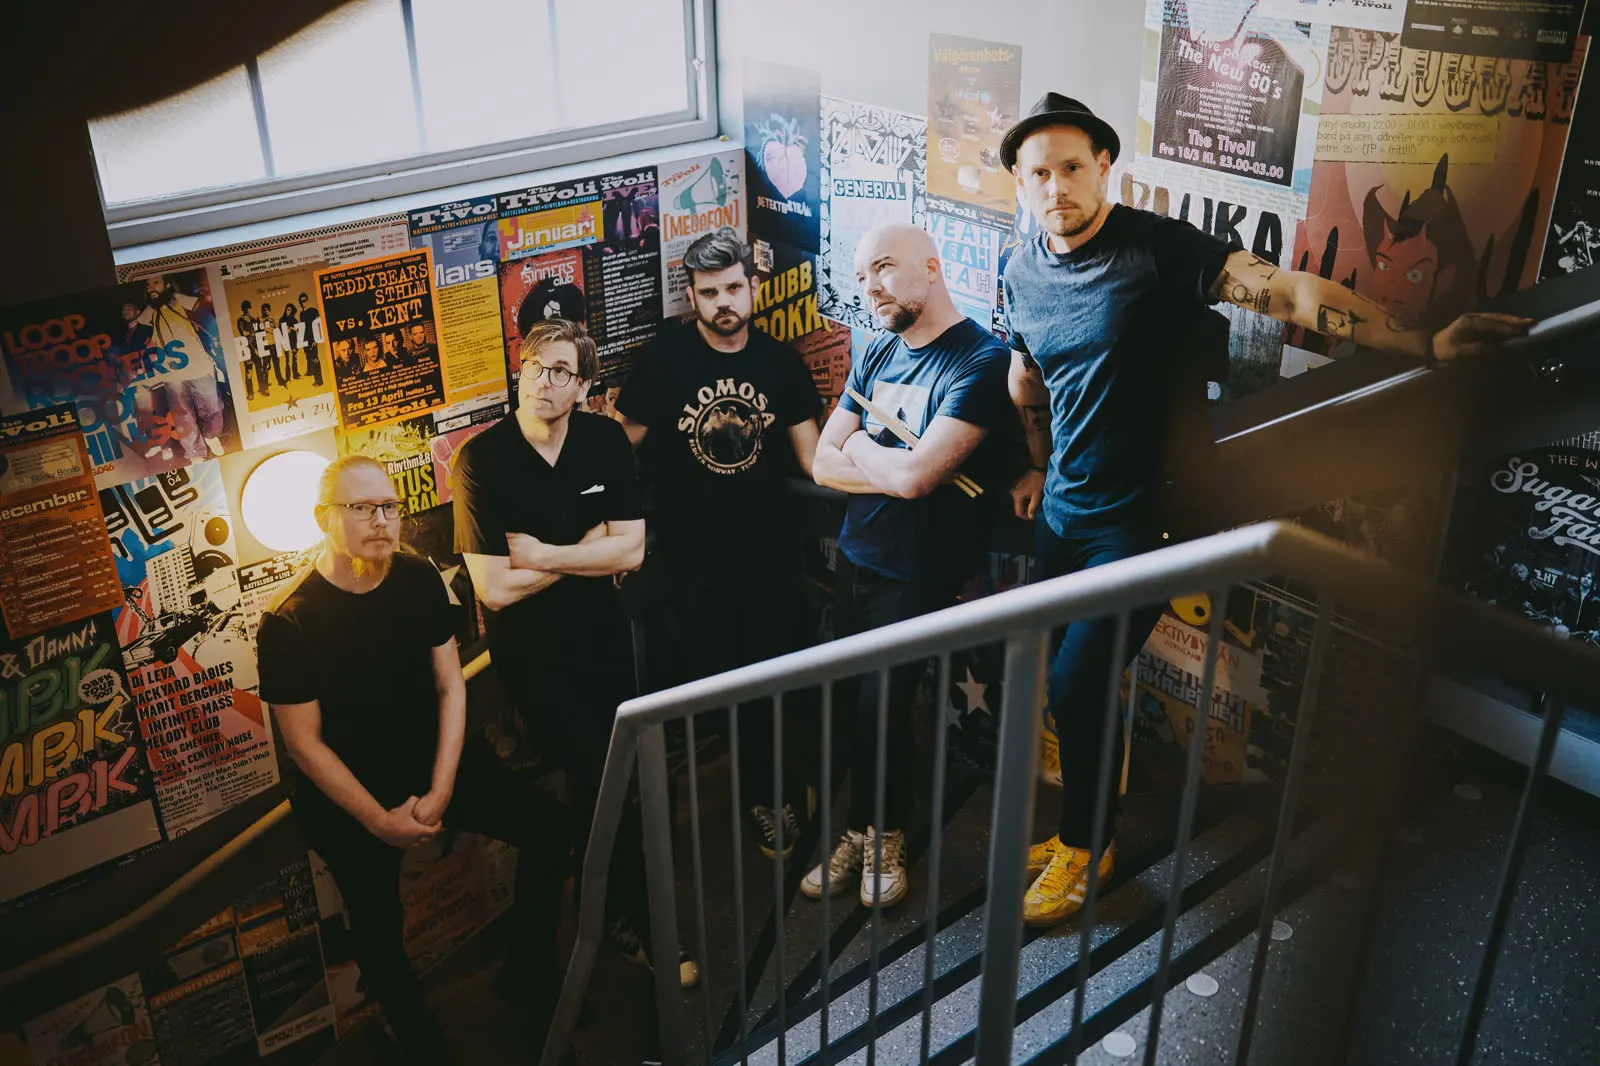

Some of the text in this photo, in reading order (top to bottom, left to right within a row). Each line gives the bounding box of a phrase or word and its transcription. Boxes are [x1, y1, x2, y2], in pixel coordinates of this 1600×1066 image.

[1178, 39, 1203, 64] The
[1208, 53, 1244, 82] New
[1188, 129, 1256, 157] The Tivoli
[1159, 142, 1175, 156] Fre
[1177, 145, 1200, 161] 18/3
[1219, 155, 1284, 179] 23.00-03.00
[528, 186, 556, 196] The
[600, 171, 655, 190] ivoli
[602, 181, 655, 201] IVE
[834, 179, 907, 200] GENERAL
[441, 201, 470, 211] The
[500, 181, 598, 209] Tivoli
[412, 197, 497, 226] Tivol
[507, 215, 595, 249] Januari
[930, 213, 991, 247] YEAH
[323, 262, 428, 300] TEDDYBEARS
[375, 280, 427, 306] STHLM
[553, 271, 574, 287] club
[753, 260, 812, 314] KLUBB
[367, 298, 422, 331] KENT
[3, 313, 86, 356] LOOP
[233, 317, 325, 362] BENZO
[347, 402, 364, 412] Fre
[367, 396, 379, 407] 13
[381, 389, 403, 403] April
[678, 378, 776, 434] SLOMOSA
[0, 411, 77, 438] voli
[707, 463, 736, 475] NORWAY
[1547, 454, 1579, 467] THE
[1491, 456, 1600, 518] Suga
[0, 489, 87, 521] ecember
[147, 666, 175, 685] LEVA
[193, 661, 233, 685] BABIES
[83, 681, 115, 699] TOUR
[138, 678, 234, 721] MARIT BERGMAN
[148, 695, 232, 735] INFINITE MASS
[191, 715, 220, 735] CLUB
[159, 747, 177, 760] The
[187, 741, 226, 765] CENTURY
[228, 730, 254, 748] NOISE
